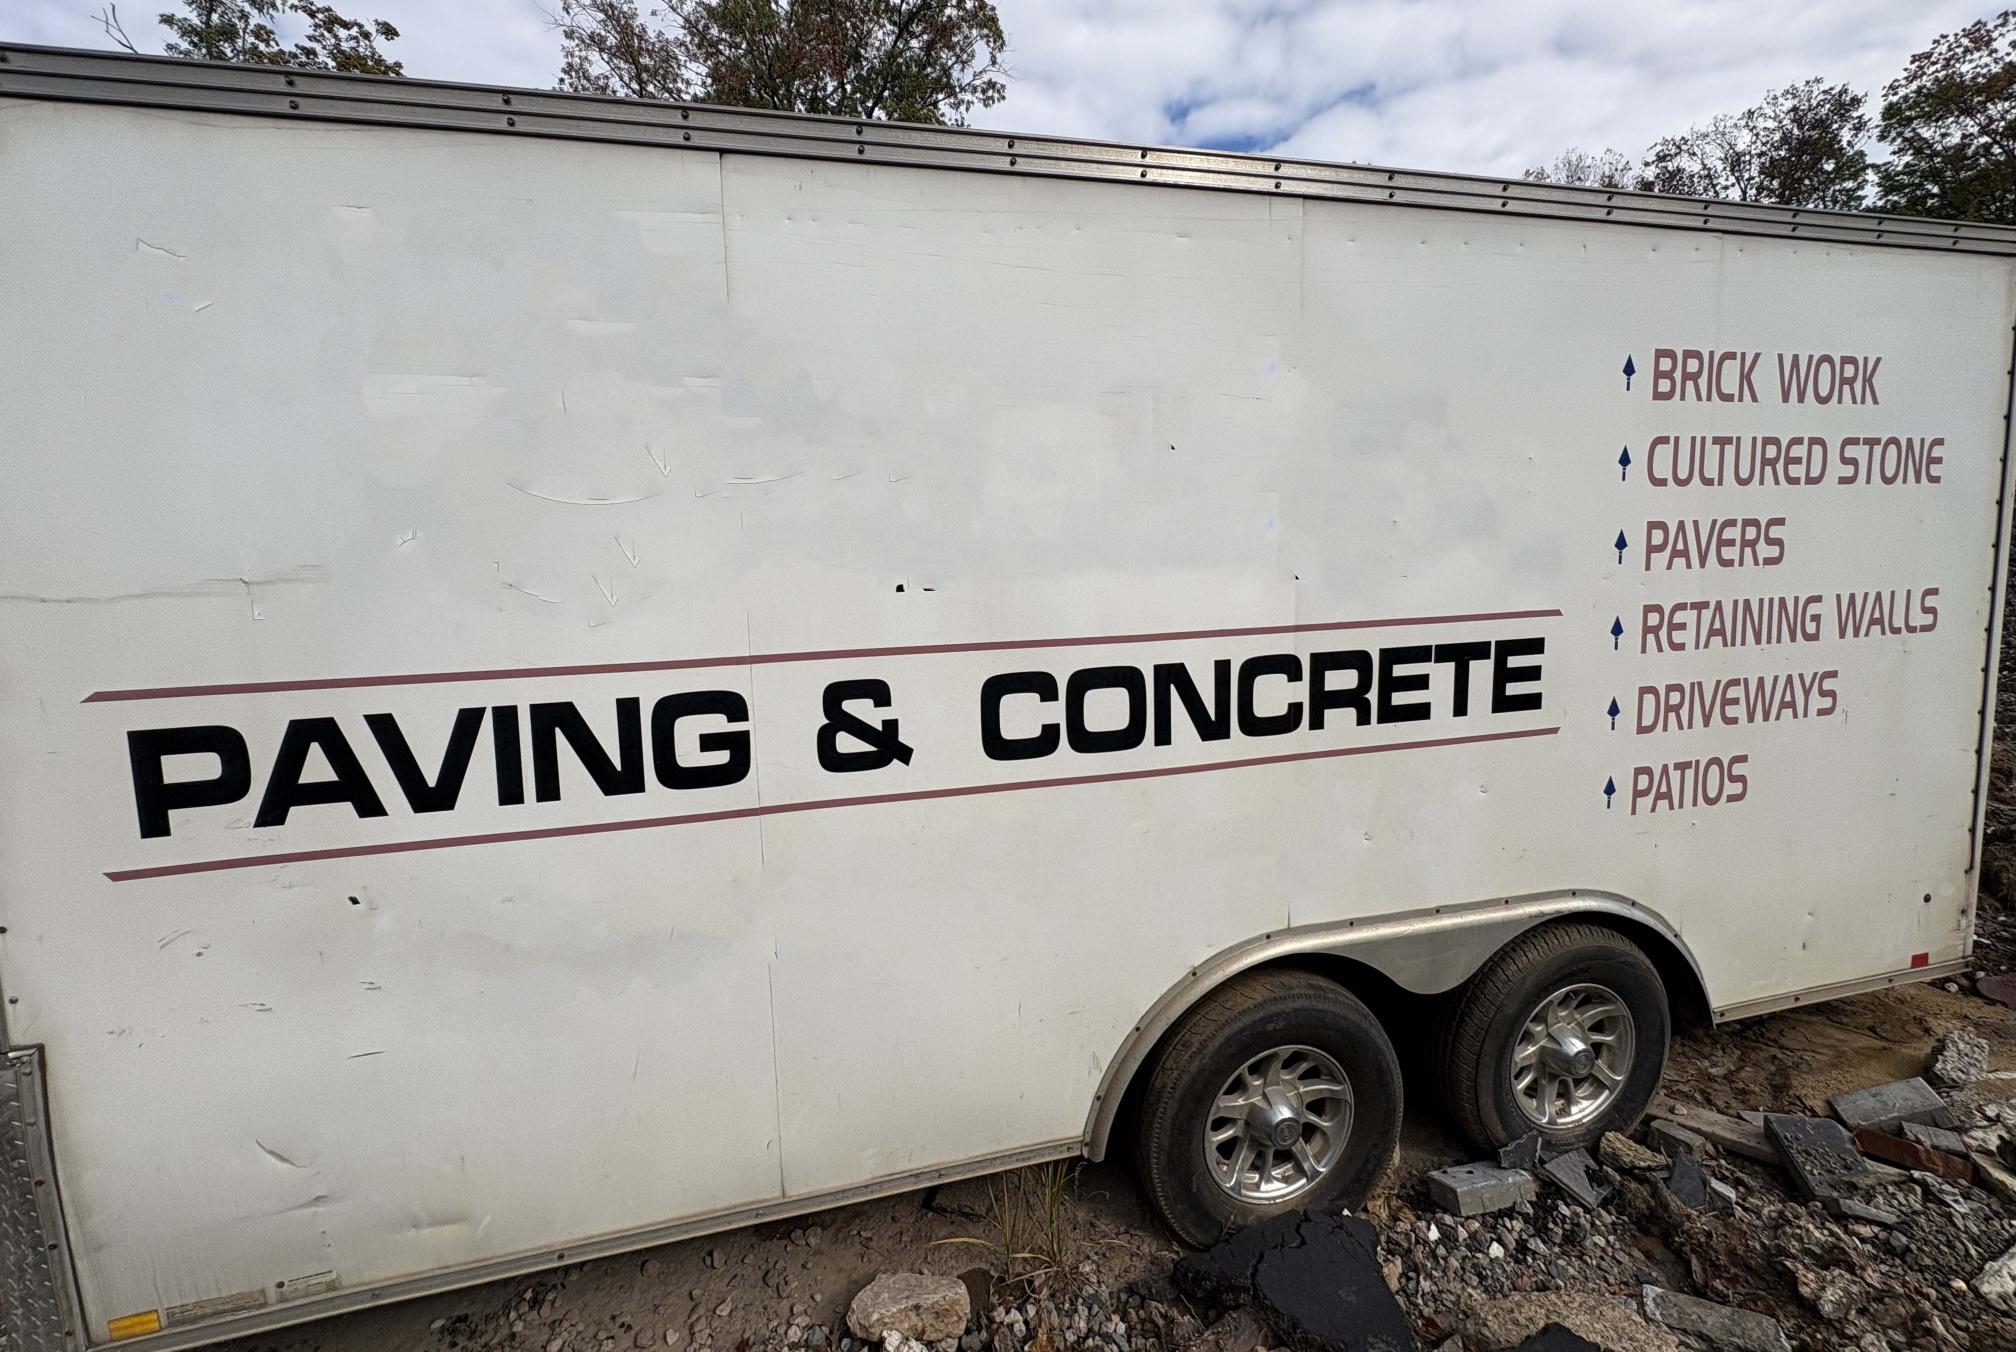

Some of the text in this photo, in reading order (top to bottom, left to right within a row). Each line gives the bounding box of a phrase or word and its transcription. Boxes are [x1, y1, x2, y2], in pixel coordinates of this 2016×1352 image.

[1651, 347, 1883, 405] BRICK WORK
[1647, 436, 1945, 488] CULTURED STONE
[1644, 517, 1787, 571] PAVERS
[1640, 587, 1940, 654] RETAINING WALLS
[1635, 669, 1839, 735] DRIVEWAYS
[127, 637, 1546, 839] PAVING & CONCRETE
[1630, 754, 1749, 816] PATIOS
